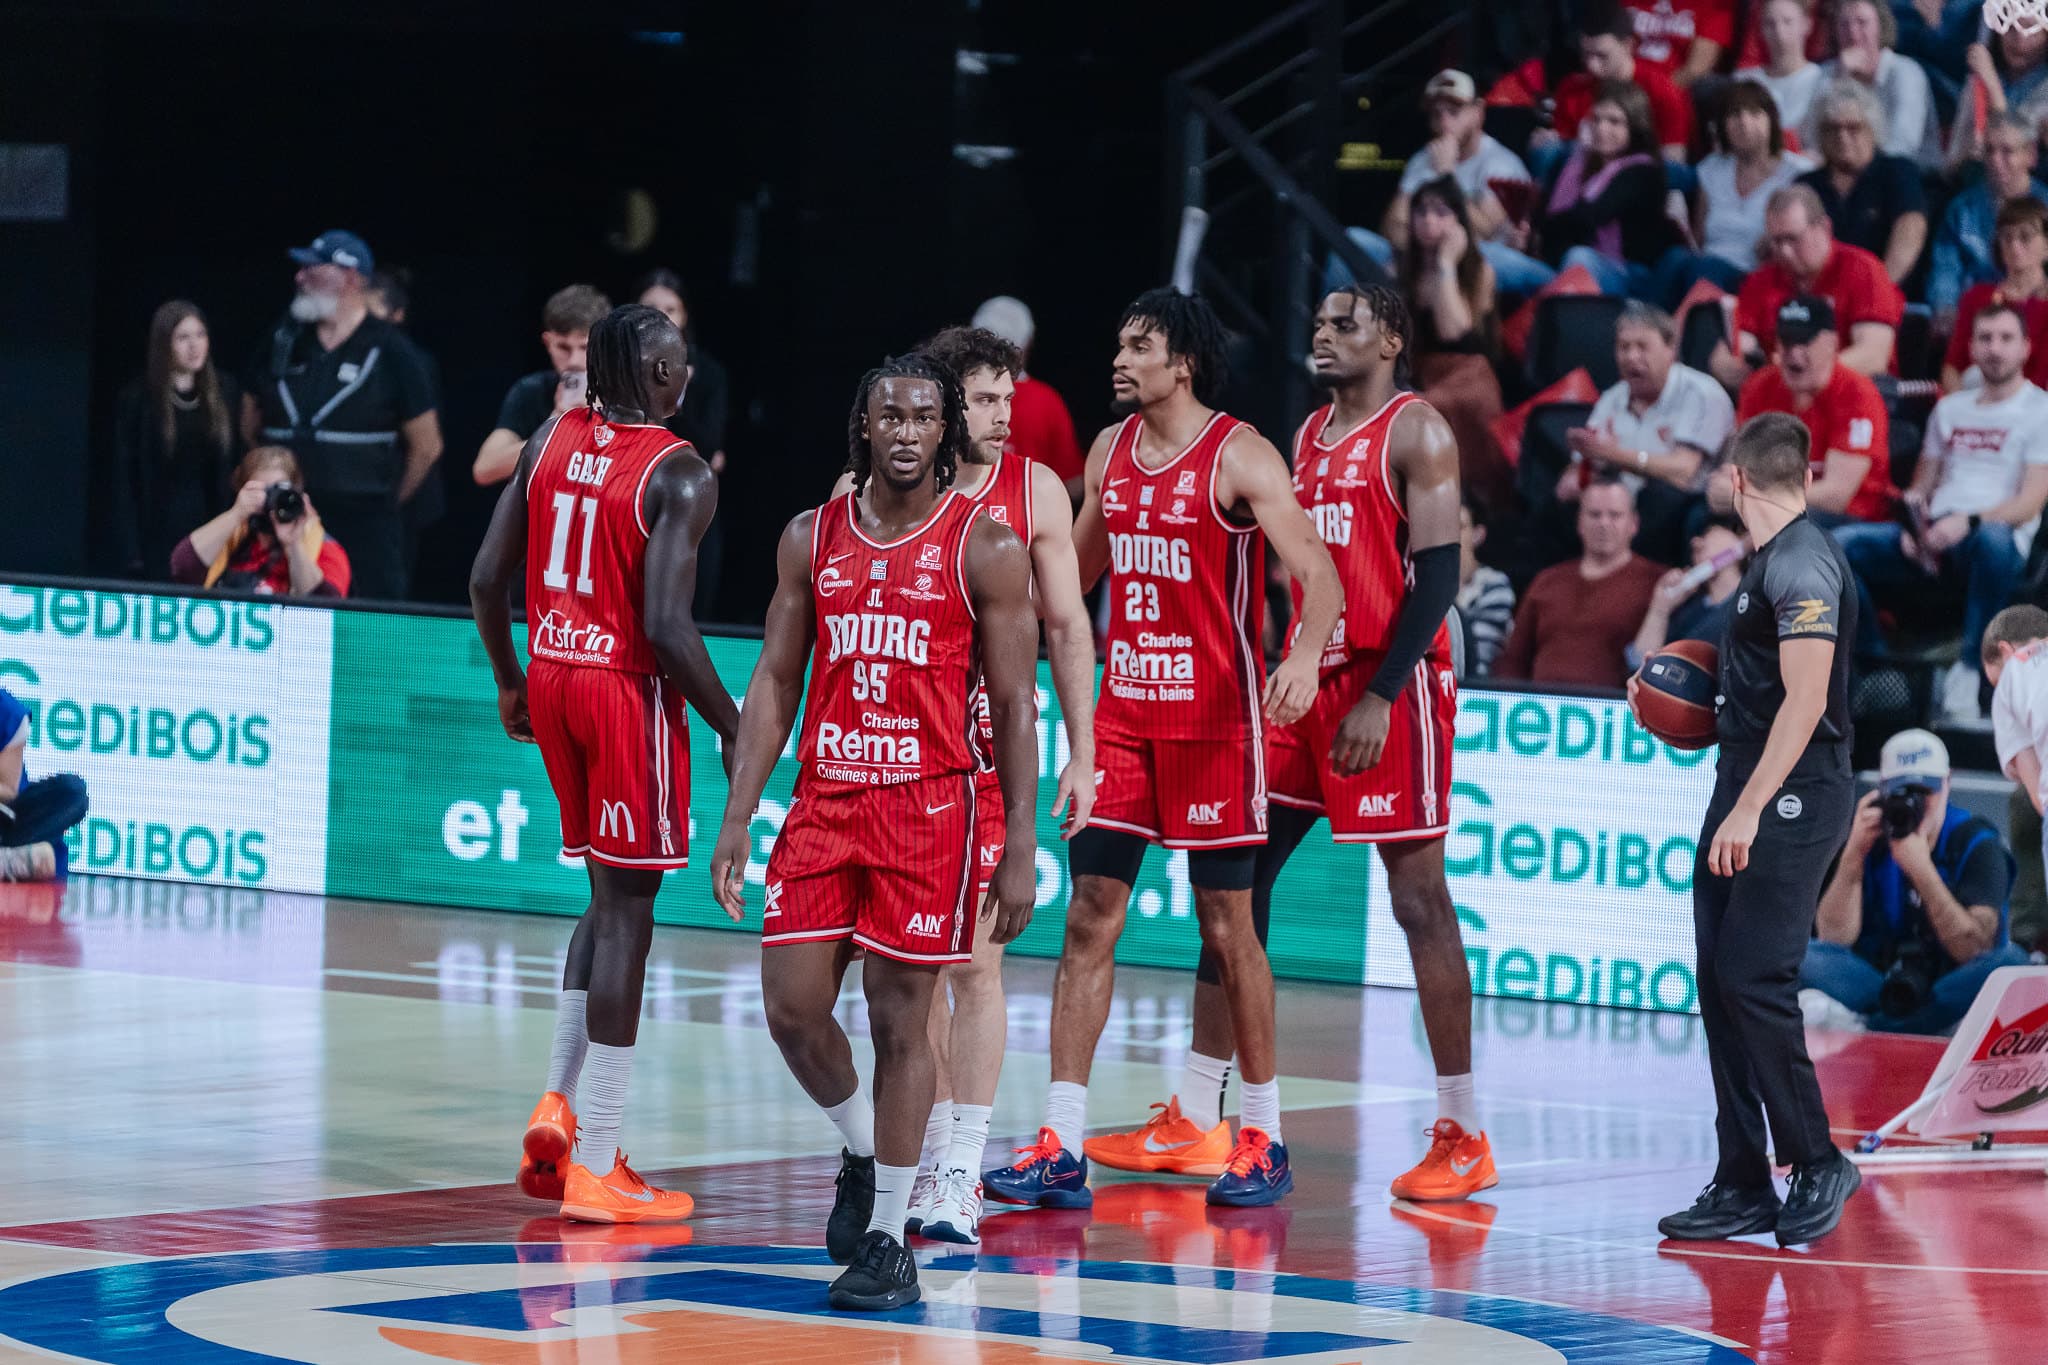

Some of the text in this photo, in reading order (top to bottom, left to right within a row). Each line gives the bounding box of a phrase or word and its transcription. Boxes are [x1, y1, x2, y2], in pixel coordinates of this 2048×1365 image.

[1304, 502, 1354, 547] URG
[544, 492, 598, 594] 11
[867, 588, 883, 607] JL
[1126, 581, 1160, 621] 23
[825, 613, 931, 666] BOURG
[1138, 632, 1193, 648] Charles
[1111, 640, 1194, 679] Réma
[852, 660, 889, 704] 95
[1159, 684, 1195, 701] bains
[862, 711, 920, 730] Charles
[816, 722, 921, 764] Réma
[816, 764, 921, 785] Cuisines & bains
[1187, 803, 1219, 823] AIN
[1357, 795, 1393, 817] AIN
[443, 790, 529, 862] et
[906, 912, 942, 934] AIN
